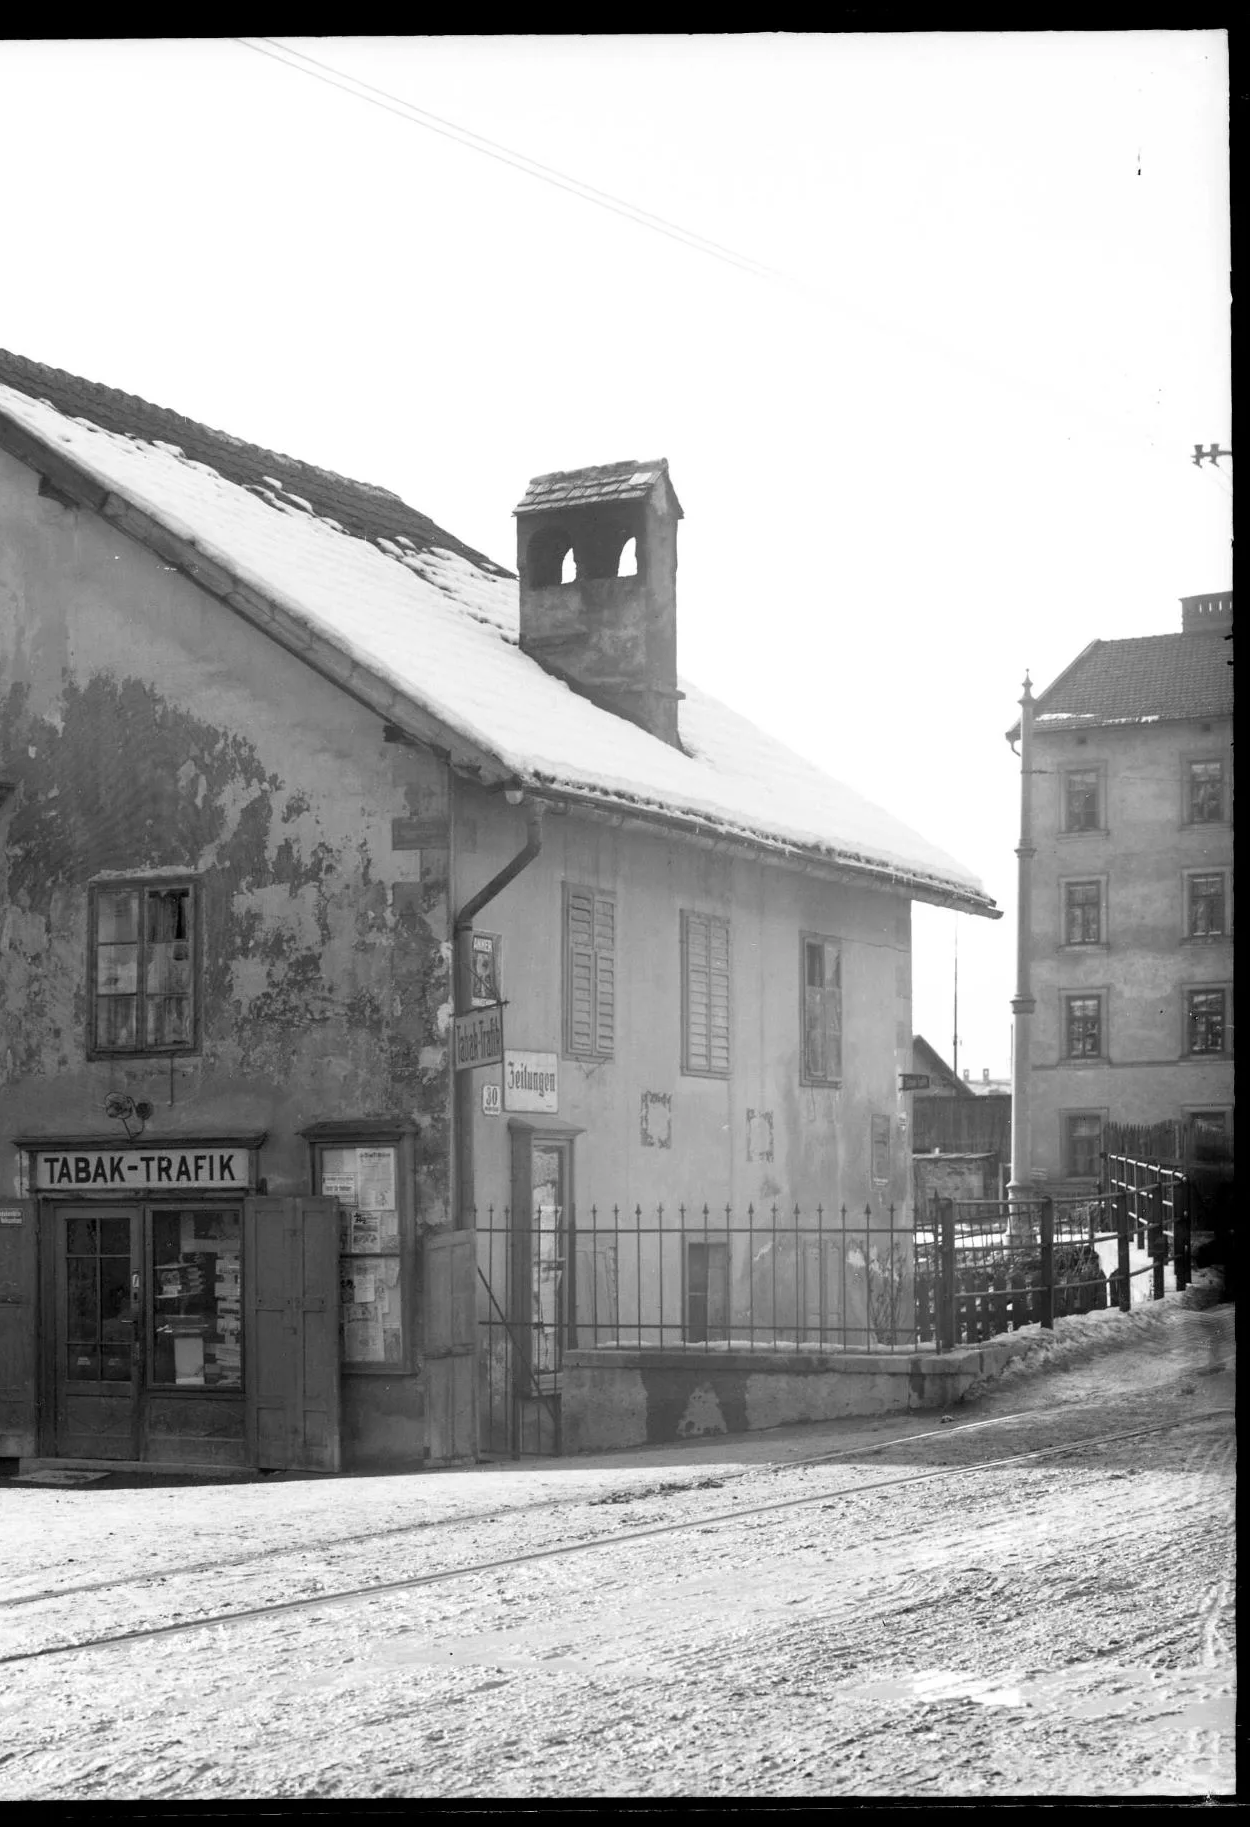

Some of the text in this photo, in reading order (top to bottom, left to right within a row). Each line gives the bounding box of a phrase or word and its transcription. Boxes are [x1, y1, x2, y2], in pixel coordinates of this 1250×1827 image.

[507, 1061, 556, 1098] Zeitungen
[485, 1087, 498, 1106] 30
[44, 1155, 236, 1184] TABAK-TRAFIK
